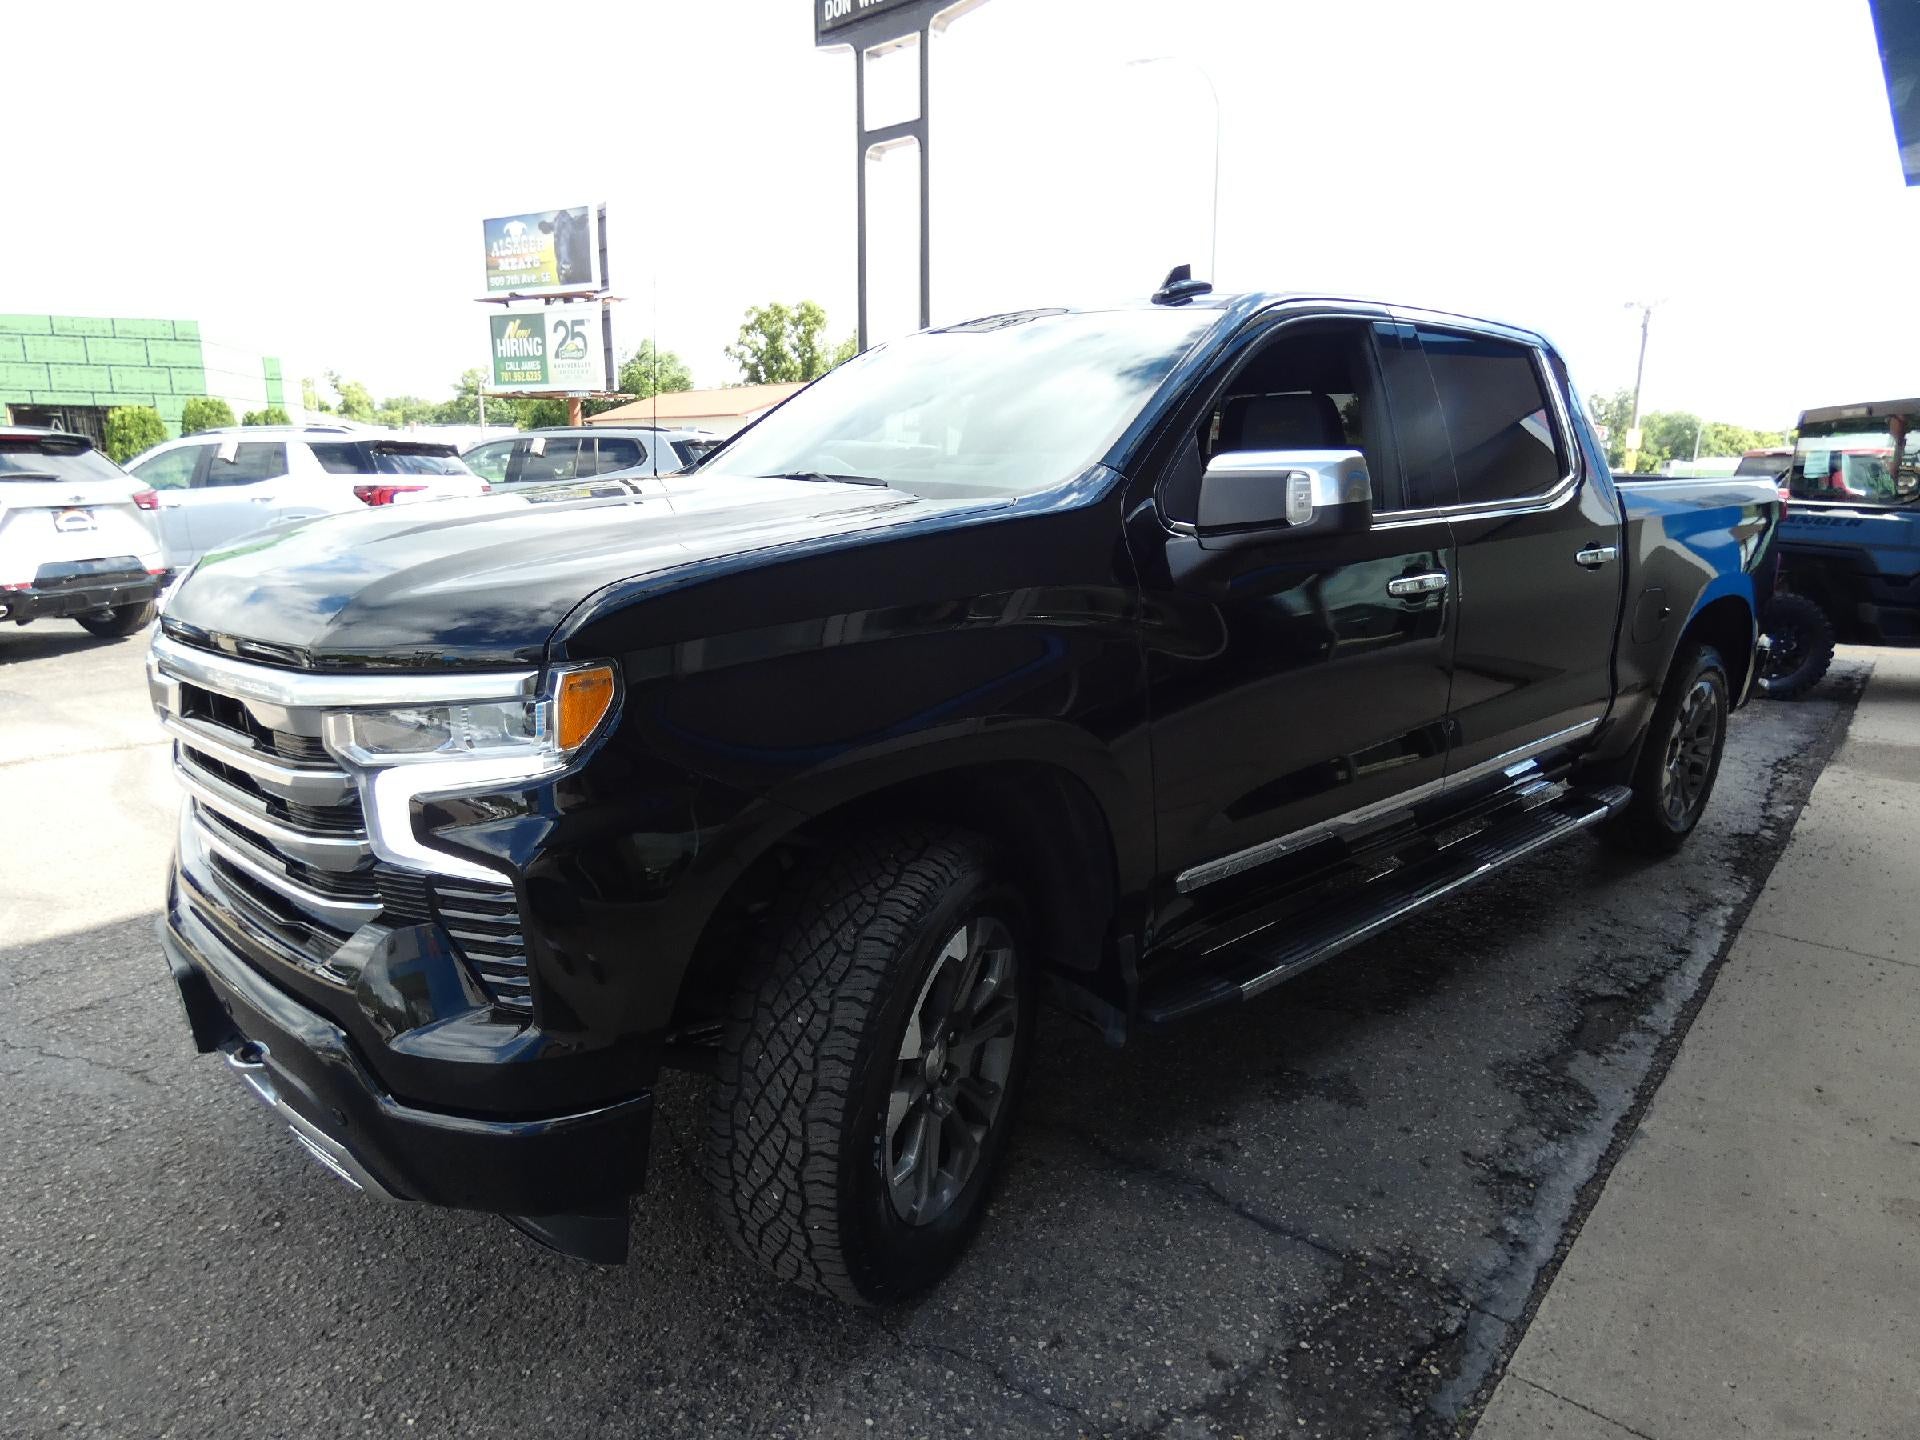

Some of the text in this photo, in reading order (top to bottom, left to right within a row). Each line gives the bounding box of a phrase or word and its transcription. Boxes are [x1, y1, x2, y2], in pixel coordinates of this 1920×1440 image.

[824, 0, 852, 21] DON
[496, 337, 543, 358] HIRING
[553, 318, 588, 360] 25
[505, 361, 520, 371] CALL
